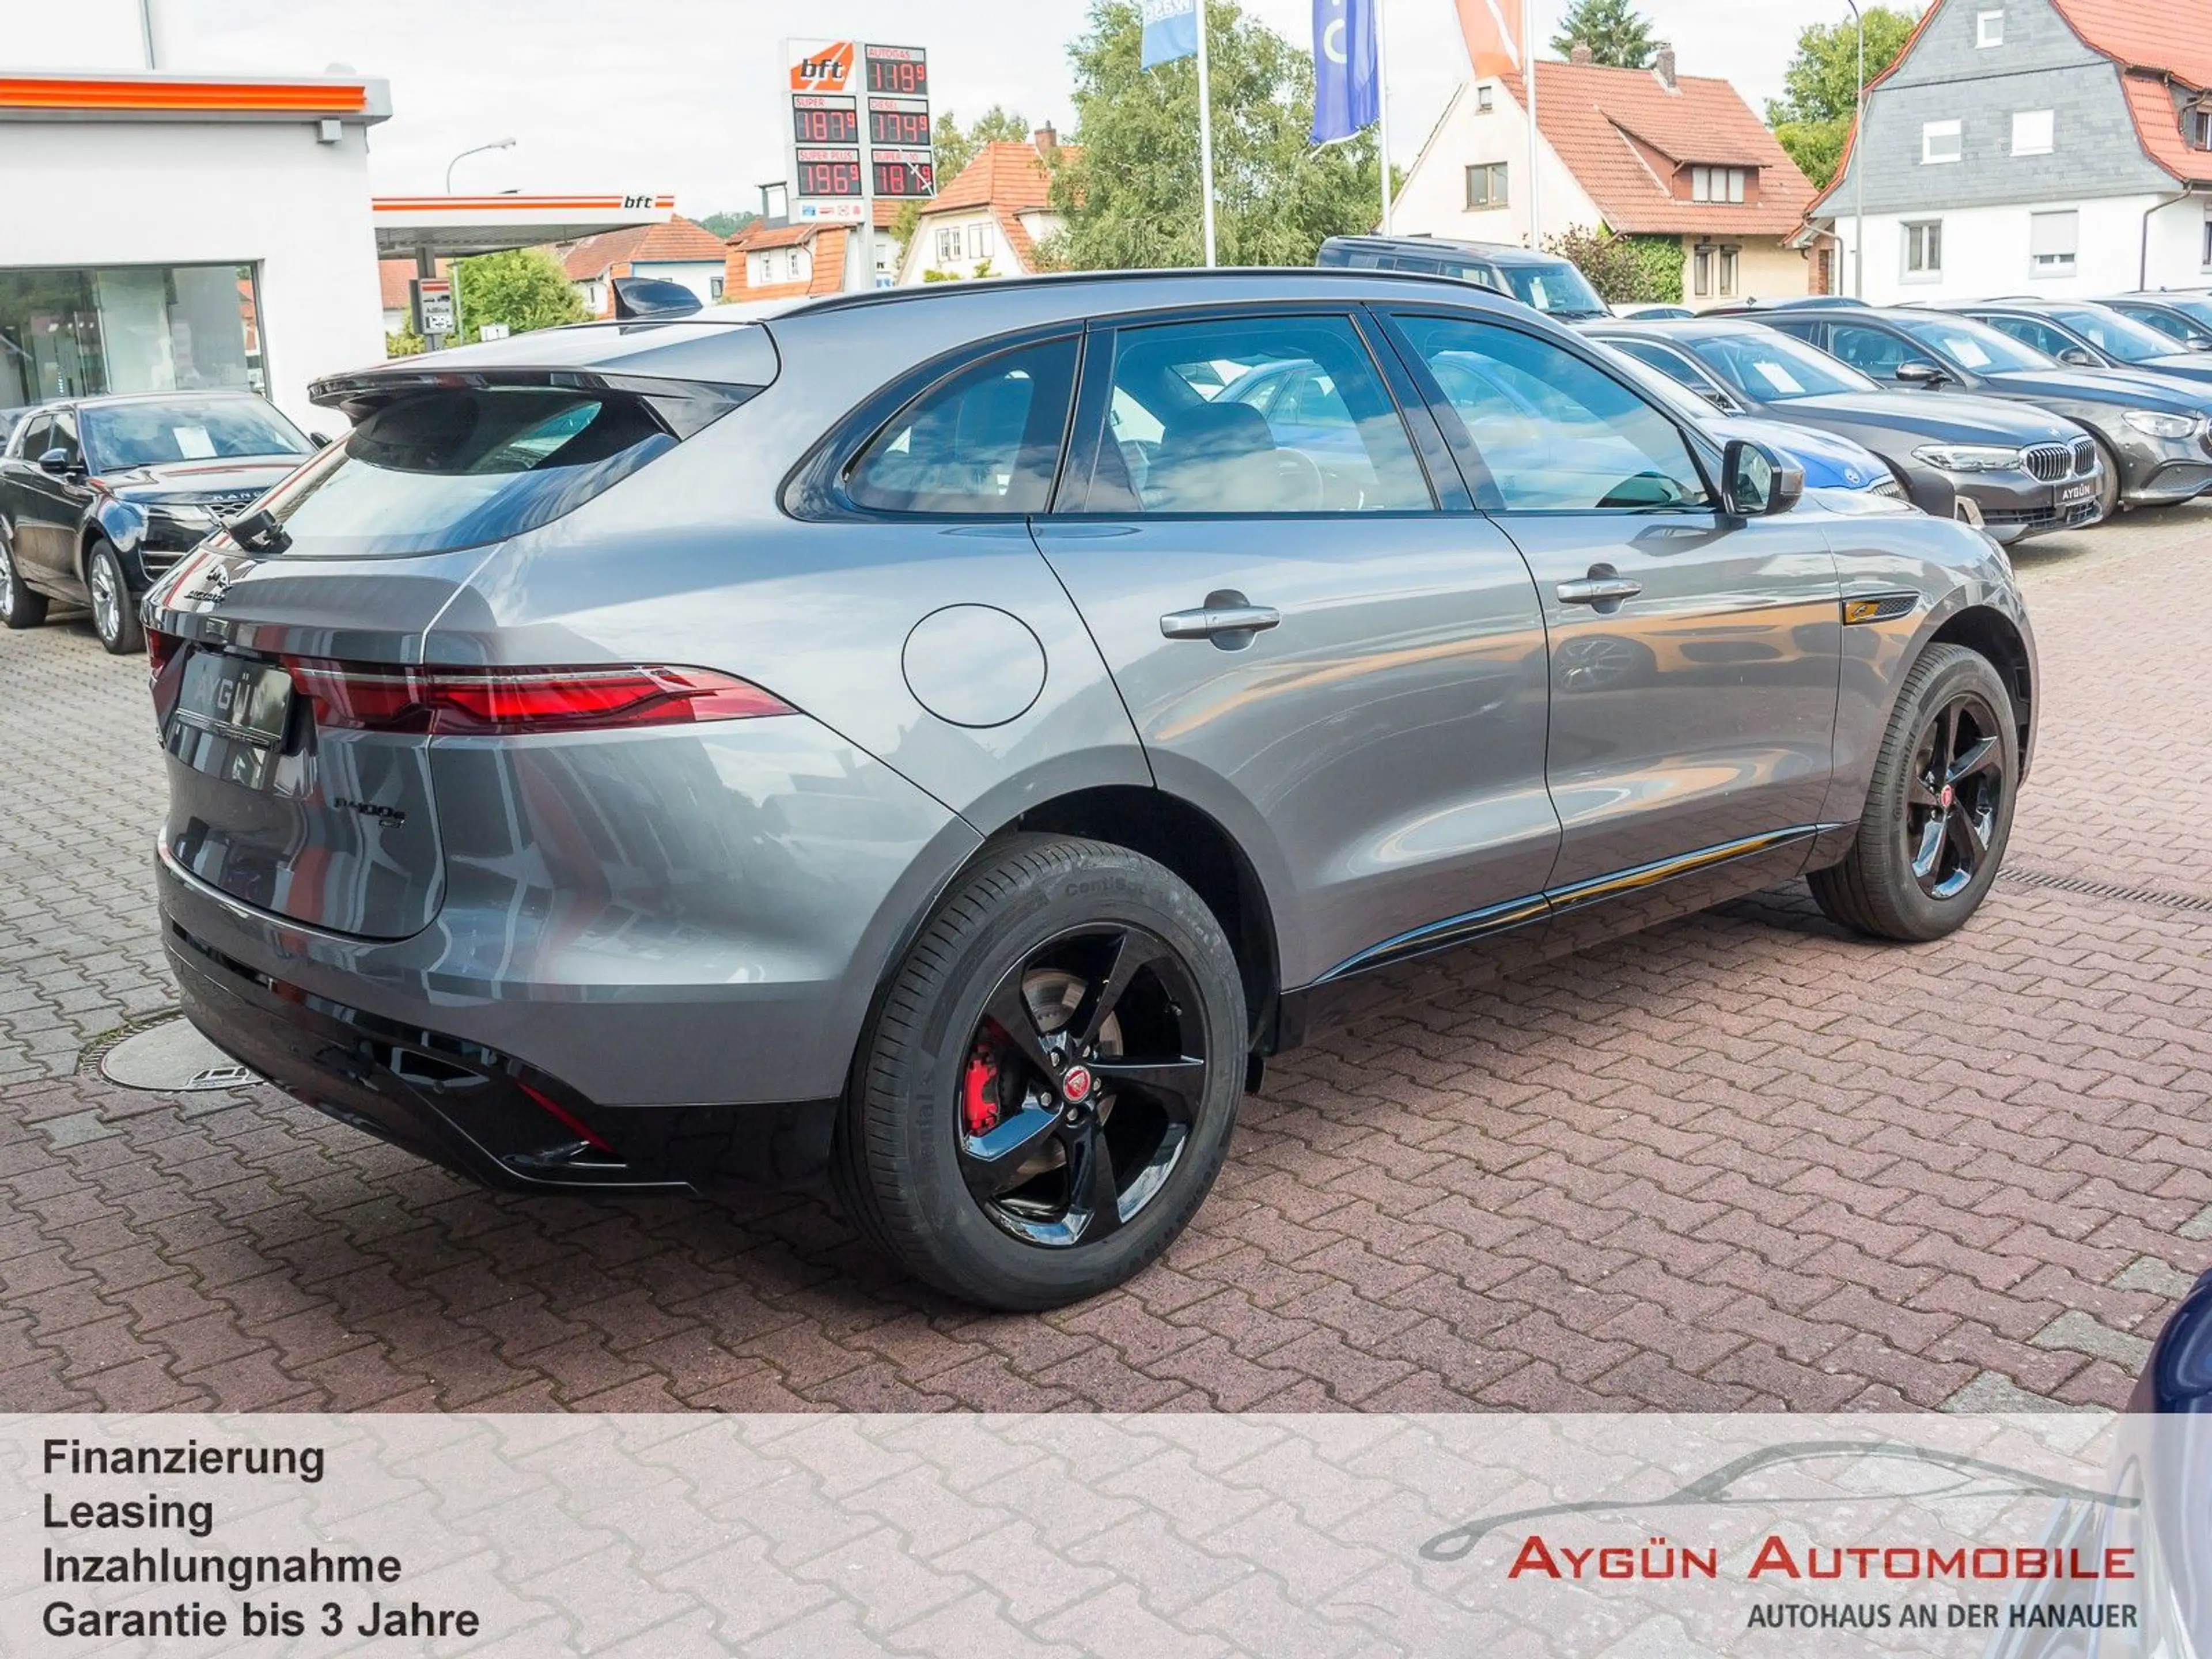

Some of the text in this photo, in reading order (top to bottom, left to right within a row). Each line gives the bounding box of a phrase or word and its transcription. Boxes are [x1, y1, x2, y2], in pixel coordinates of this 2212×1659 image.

[801, 58, 842, 78] bft
[796, 97, 824, 107] SUPER
[800, 150, 852, 160] SUPER PLUS
[624, 195, 653, 208] bft
